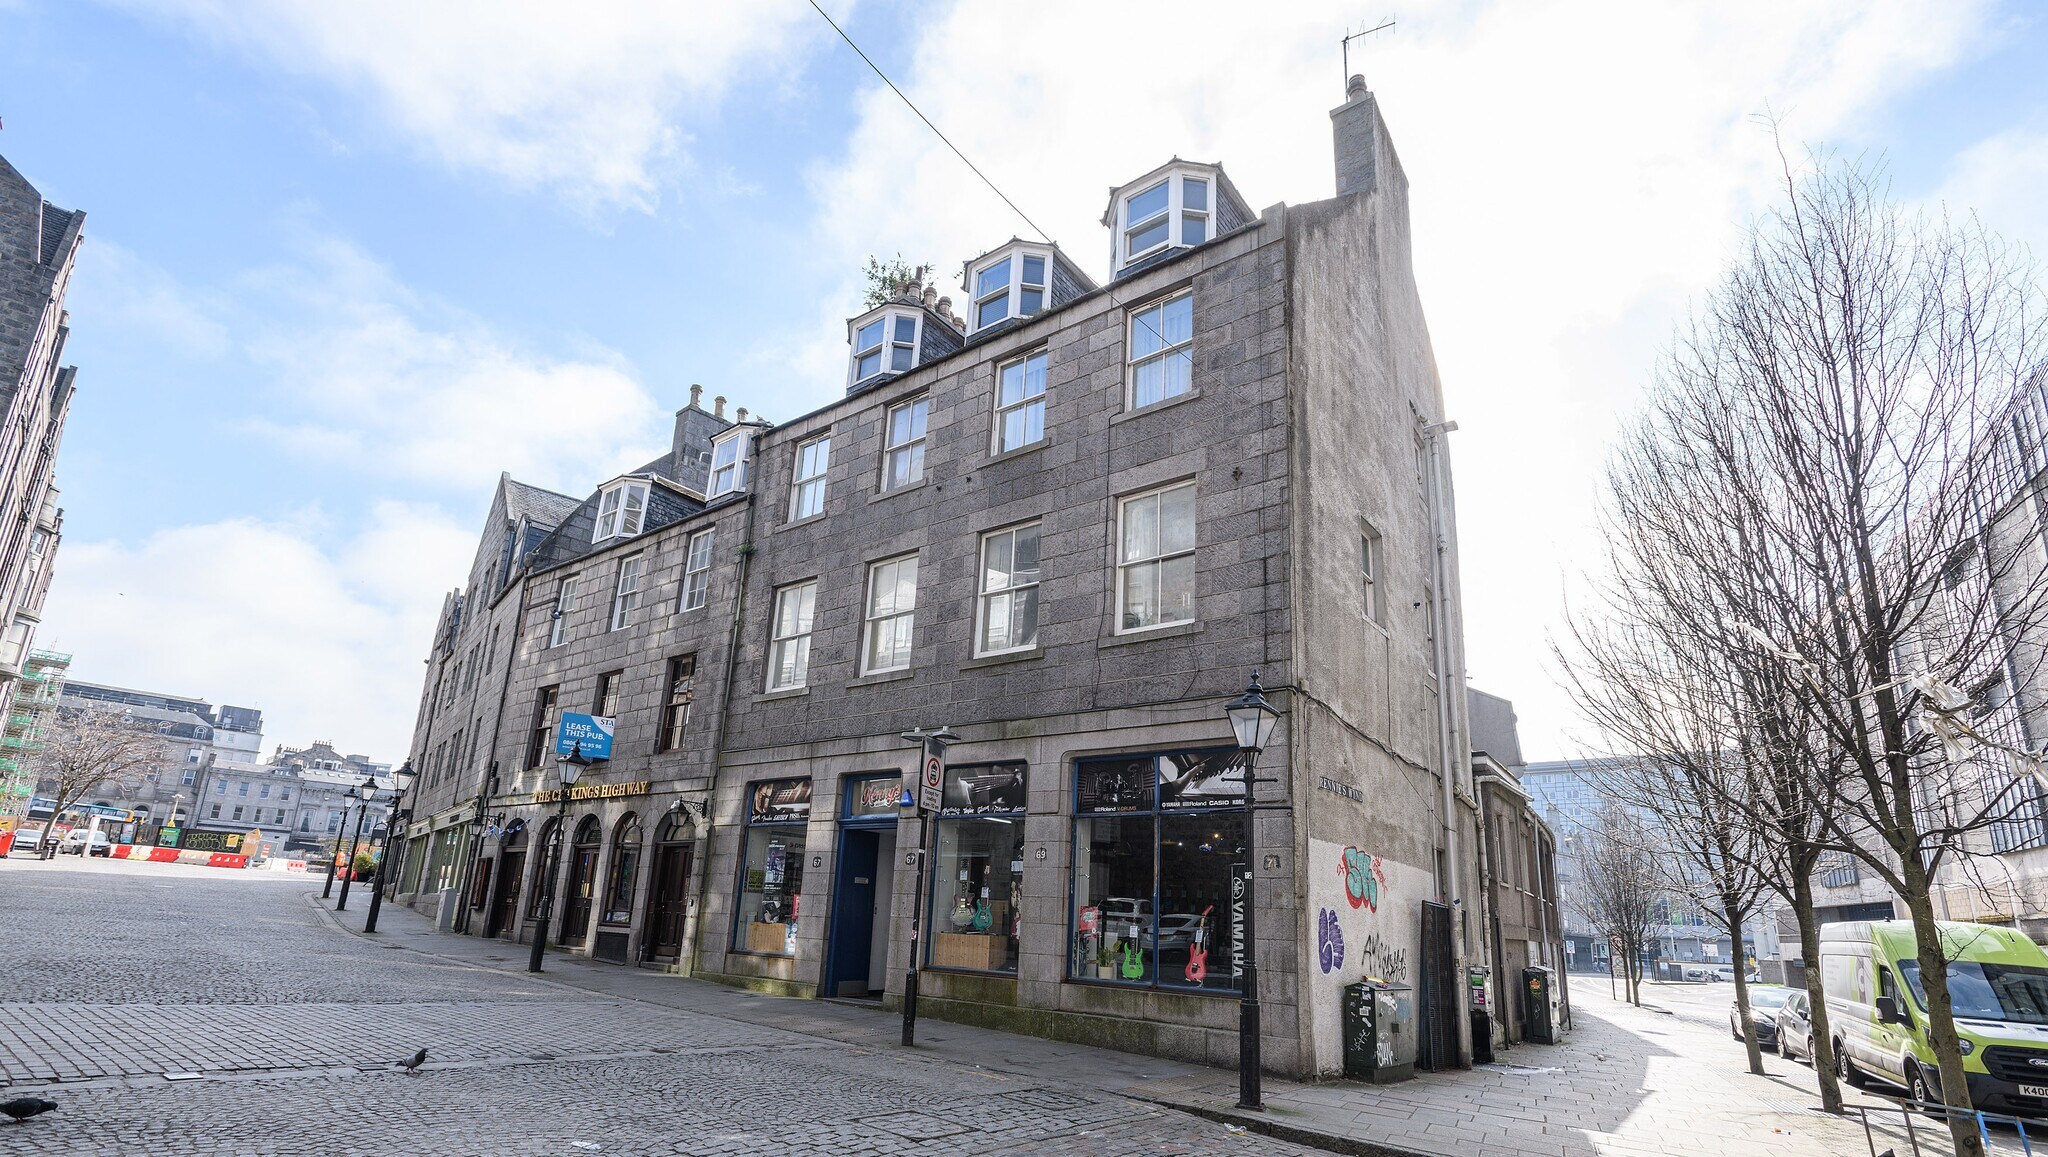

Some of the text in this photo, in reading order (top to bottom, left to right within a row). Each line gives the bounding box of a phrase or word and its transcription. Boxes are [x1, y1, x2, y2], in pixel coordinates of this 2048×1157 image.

[566, 722, 591, 732] LEASE
[565, 728, 605, 741] THIS PUB.
[532, 790, 550, 803] THE
[571, 785, 599, 800] KINGS
[601, 780, 648, 798] HIGHWAY
[906, 855, 915, 864] 67
[1035, 850, 1046, 859] 69
[1233, 900, 1245, 978] YAMAHA
